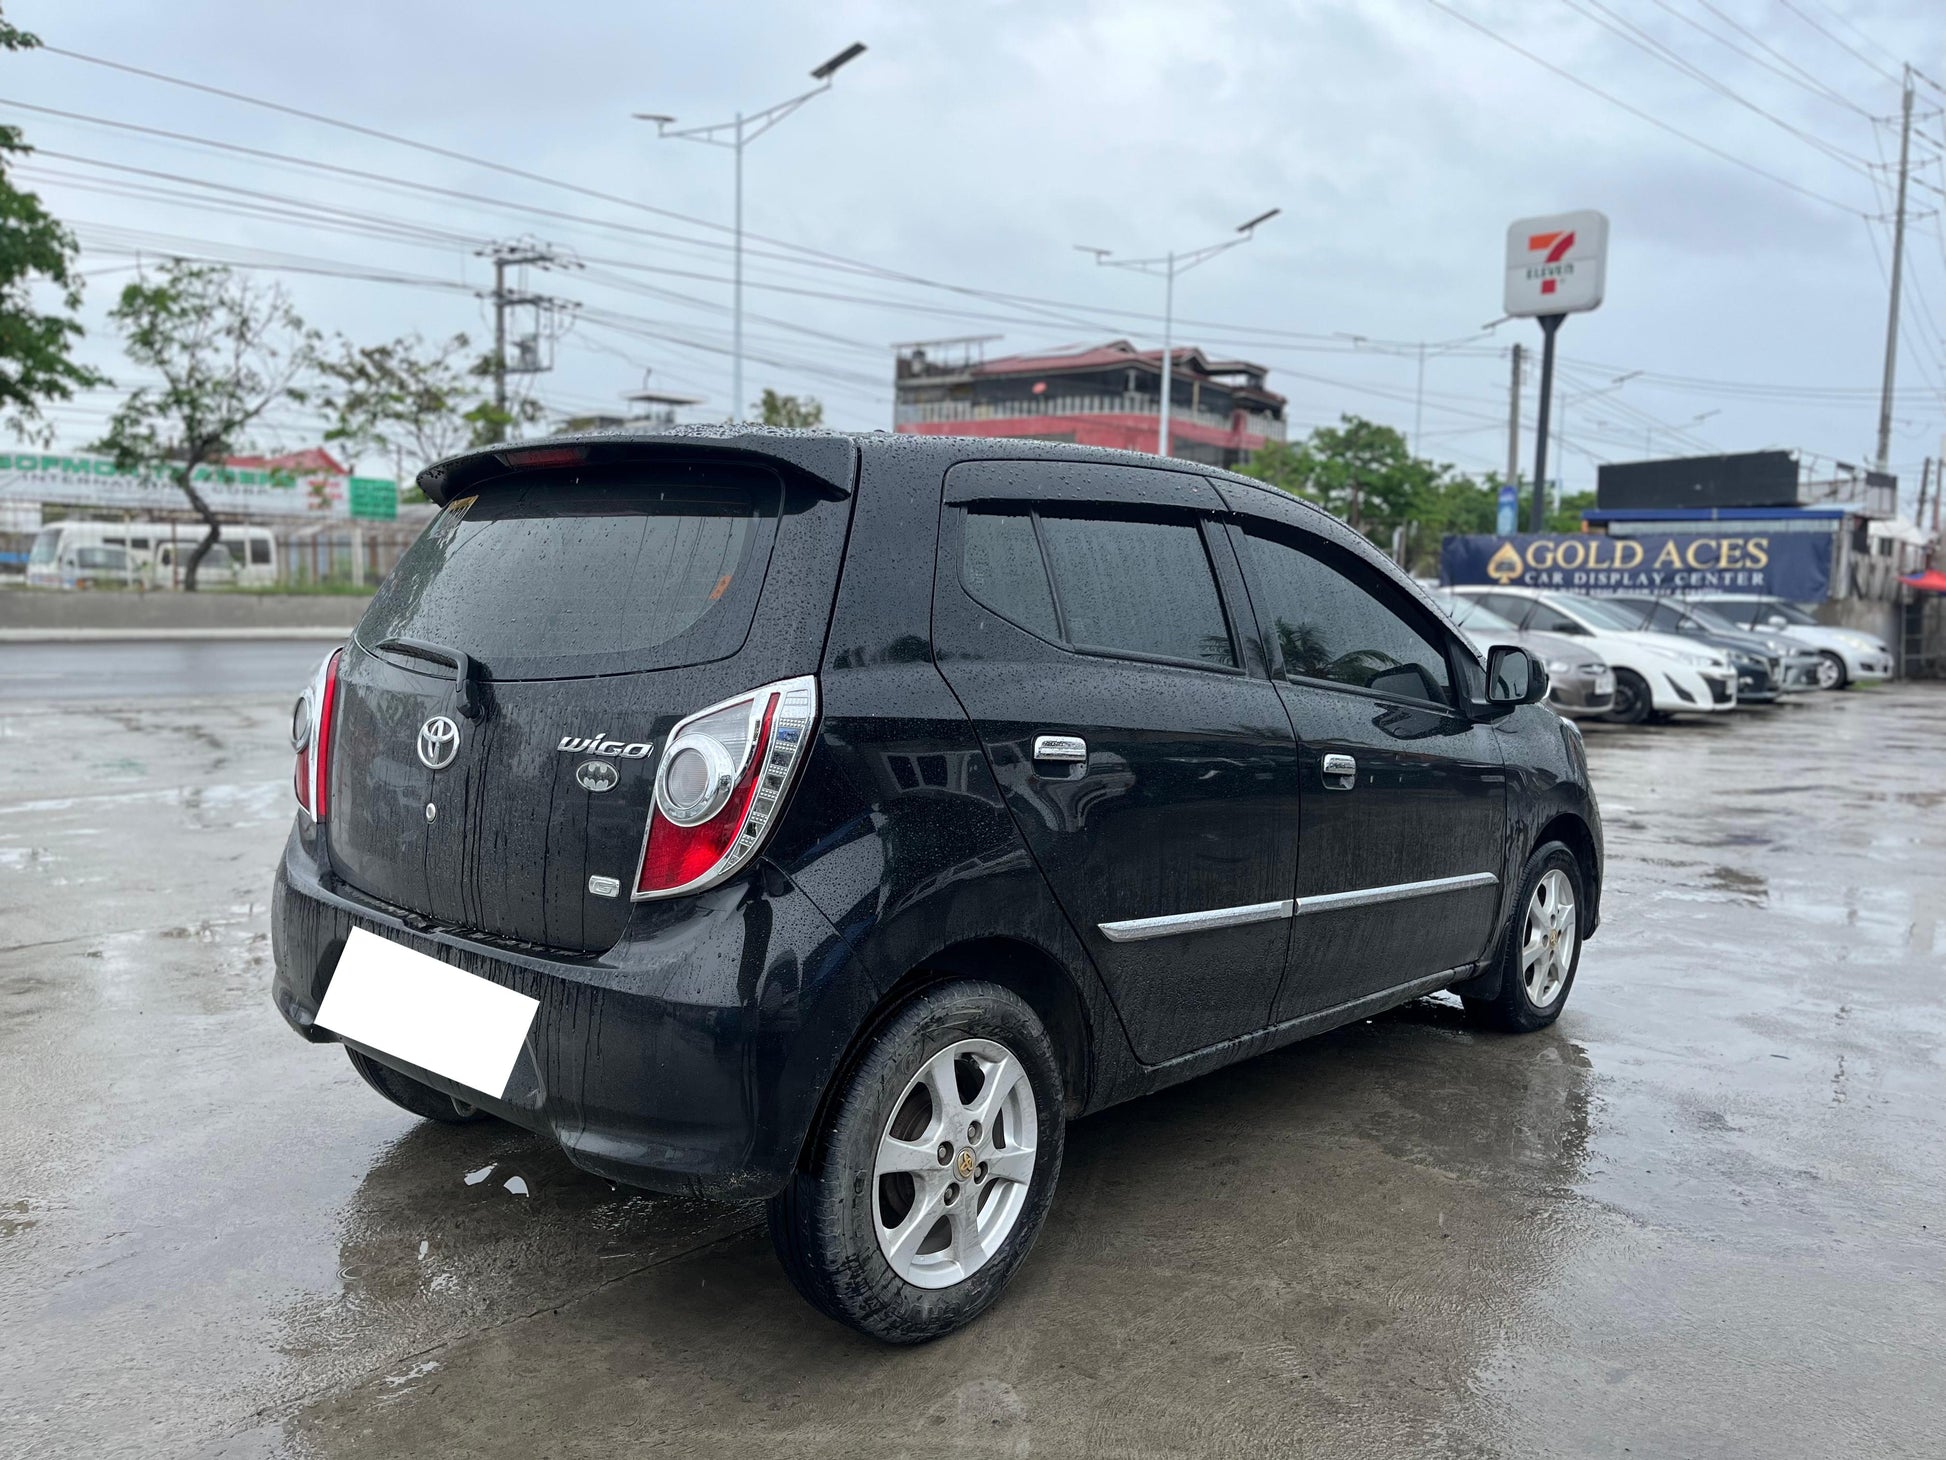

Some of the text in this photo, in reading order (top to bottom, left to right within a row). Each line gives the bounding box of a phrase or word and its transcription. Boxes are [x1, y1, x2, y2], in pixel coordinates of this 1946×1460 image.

[1525, 536, 1769, 570] GOLD ACES
[1524, 571, 1765, 587] CAR DISPLAY CENTER
